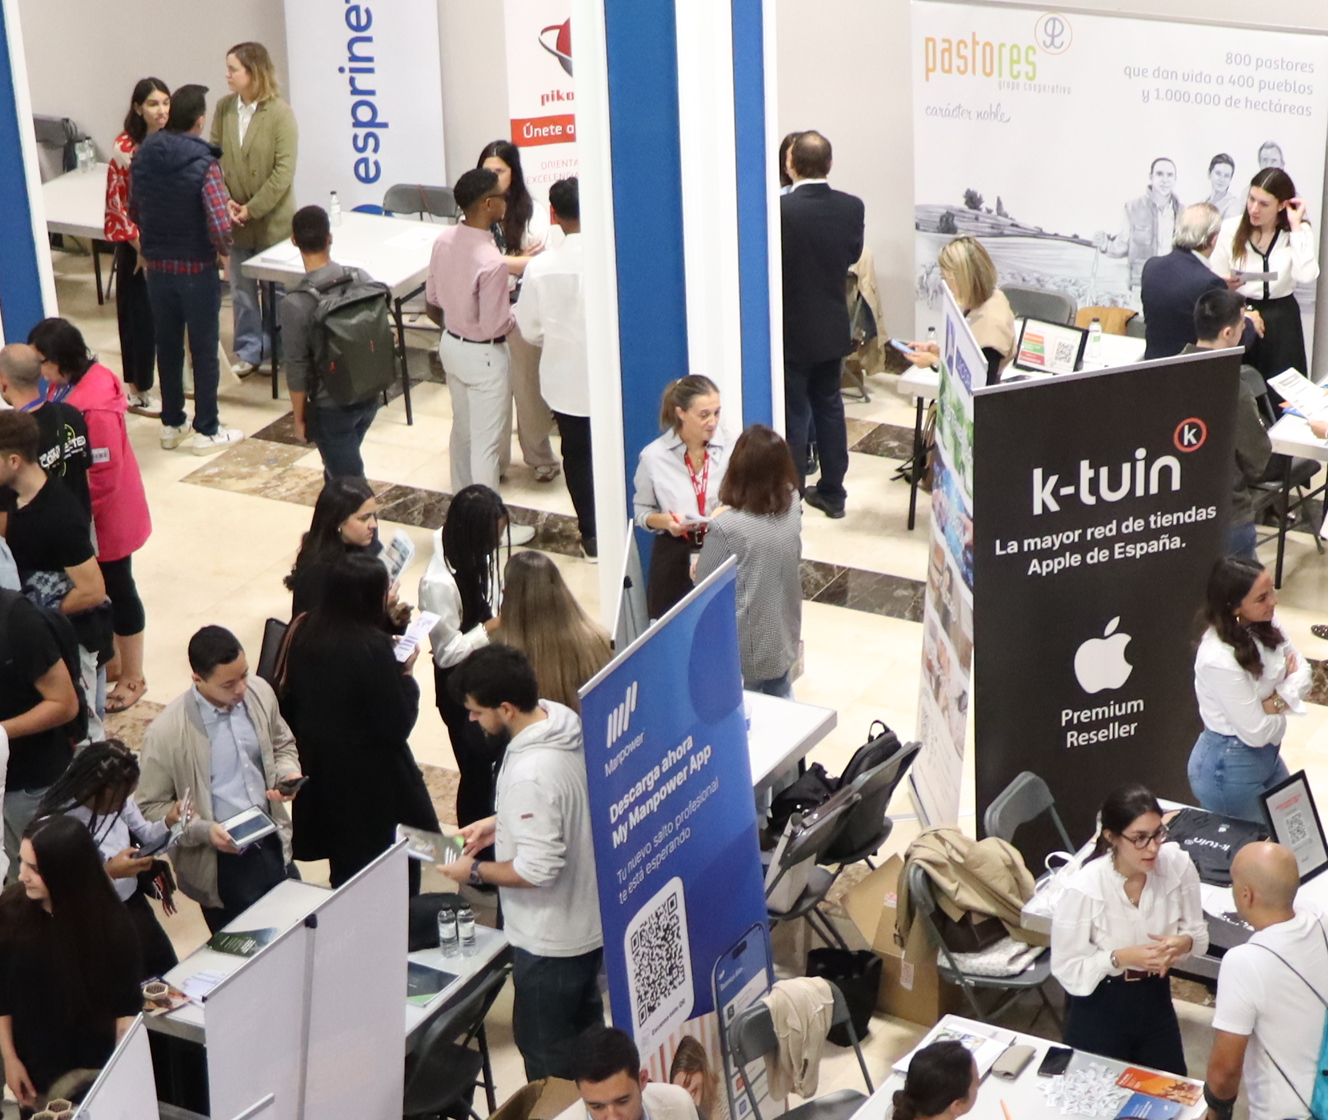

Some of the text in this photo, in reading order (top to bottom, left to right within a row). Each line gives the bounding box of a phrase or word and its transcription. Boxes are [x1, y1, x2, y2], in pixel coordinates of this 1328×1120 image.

[925, 31, 1037, 82] pastores
[1225, 51, 1315, 73] 800 pastores
[338, 0, 389, 184] esprine
[998, 79, 1072, 95] grupo cooperativo
[1124, 65, 1314, 95] que dan vida a 400 pueblos
[925, 102, 1011, 123] carácter noble
[1142, 88, 1313, 117] y 1.000.000 de hectáreas
[523, 120, 562, 138] Únete
[1183, 425, 1197, 446] k
[1032, 447, 1181, 516] k-tuin
[995, 505, 1217, 555] La mayor red de tiendas
[1027, 532, 1186, 576] Apple de España.
[1061, 699, 1144, 727] Premium
[1067, 721, 1138, 748] Reseller
[604, 733, 644, 777] Manpower
[609, 735, 694, 824] Descarga ahora
[612, 745, 712, 849] My Manpower App
[617, 776, 719, 884] Tu nuevo salto profesional
[1193, 836, 1231, 852] k-tuin
[619, 826, 691, 904] te está esperando
